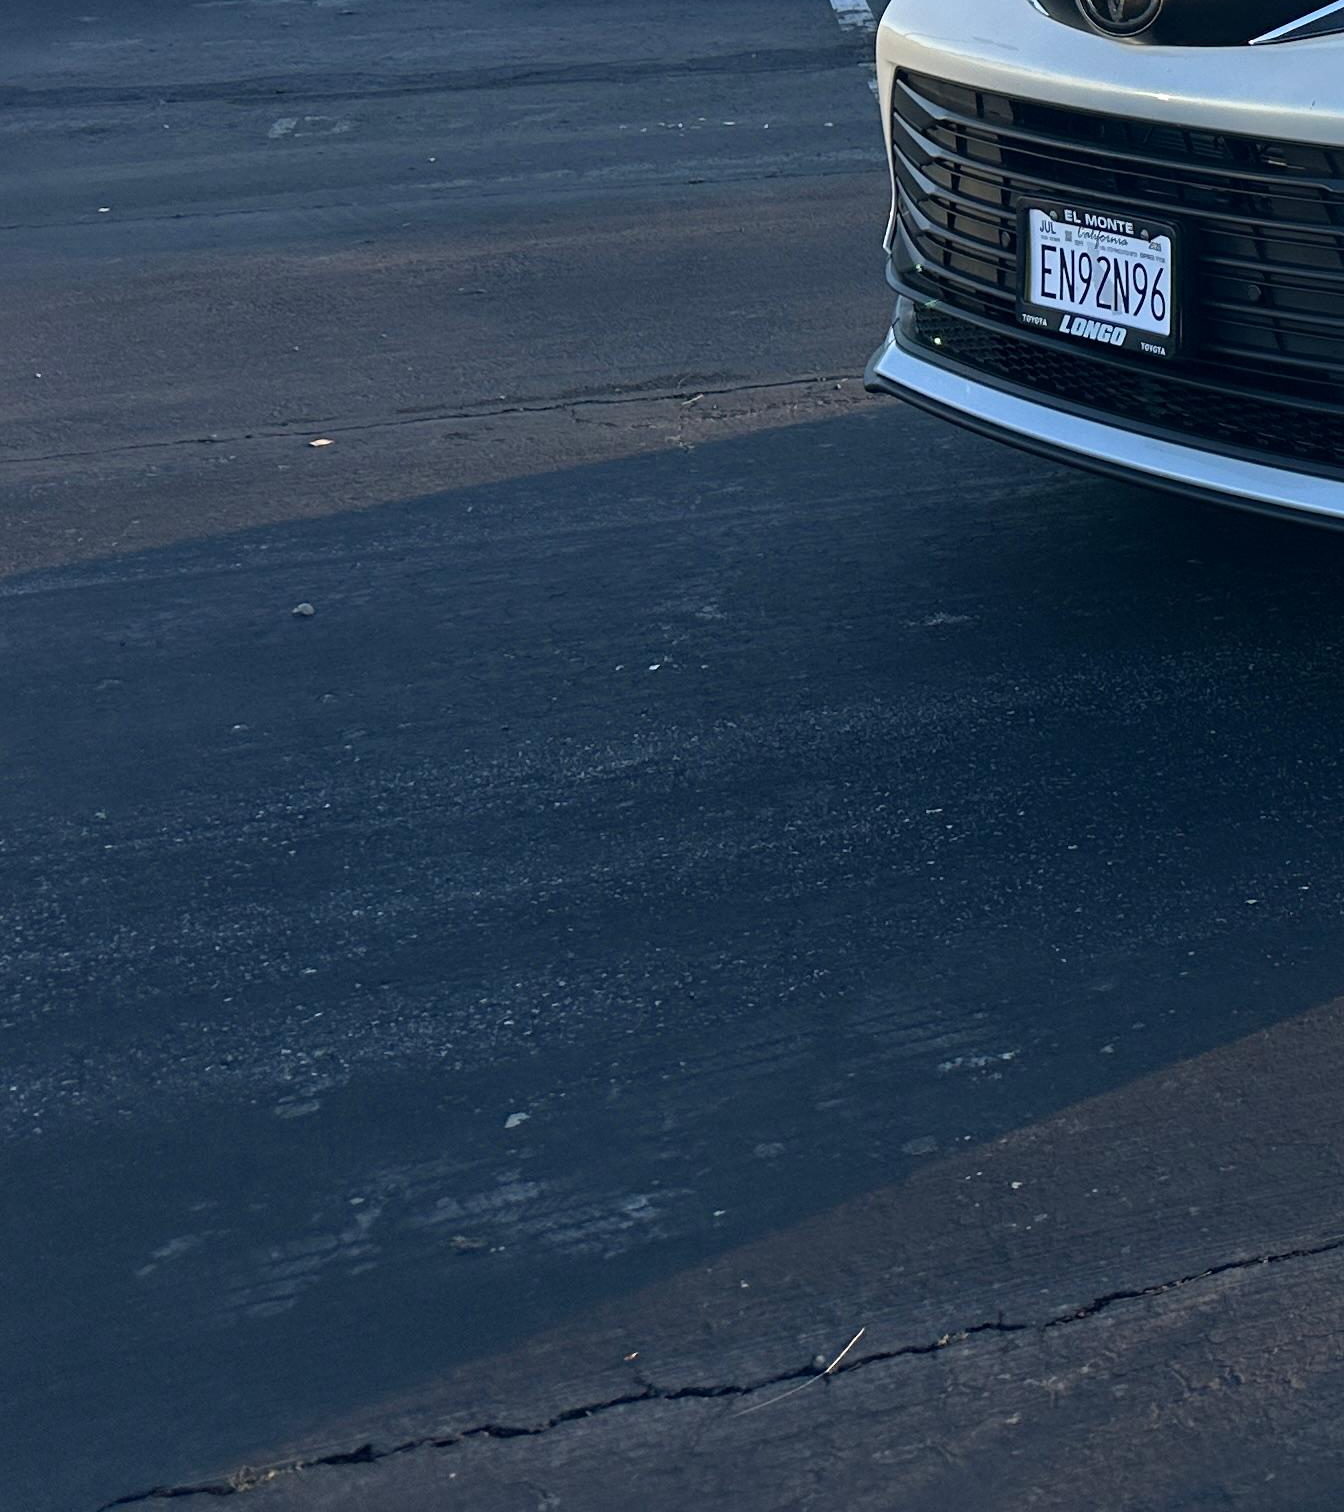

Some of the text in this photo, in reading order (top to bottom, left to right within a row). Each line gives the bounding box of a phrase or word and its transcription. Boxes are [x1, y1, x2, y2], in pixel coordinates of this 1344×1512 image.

[1040, 219, 1056, 234] JUL
[1064, 209, 1134, 234] EL MONTE
[1077, 226, 1128, 249] California
[1041, 244, 1166, 322] EN92N96
[1021, 313, 1048, 327] TOYOTA
[1059, 314, 1126, 346] LONGO
[1140, 341, 1166, 356] TOYOTA
